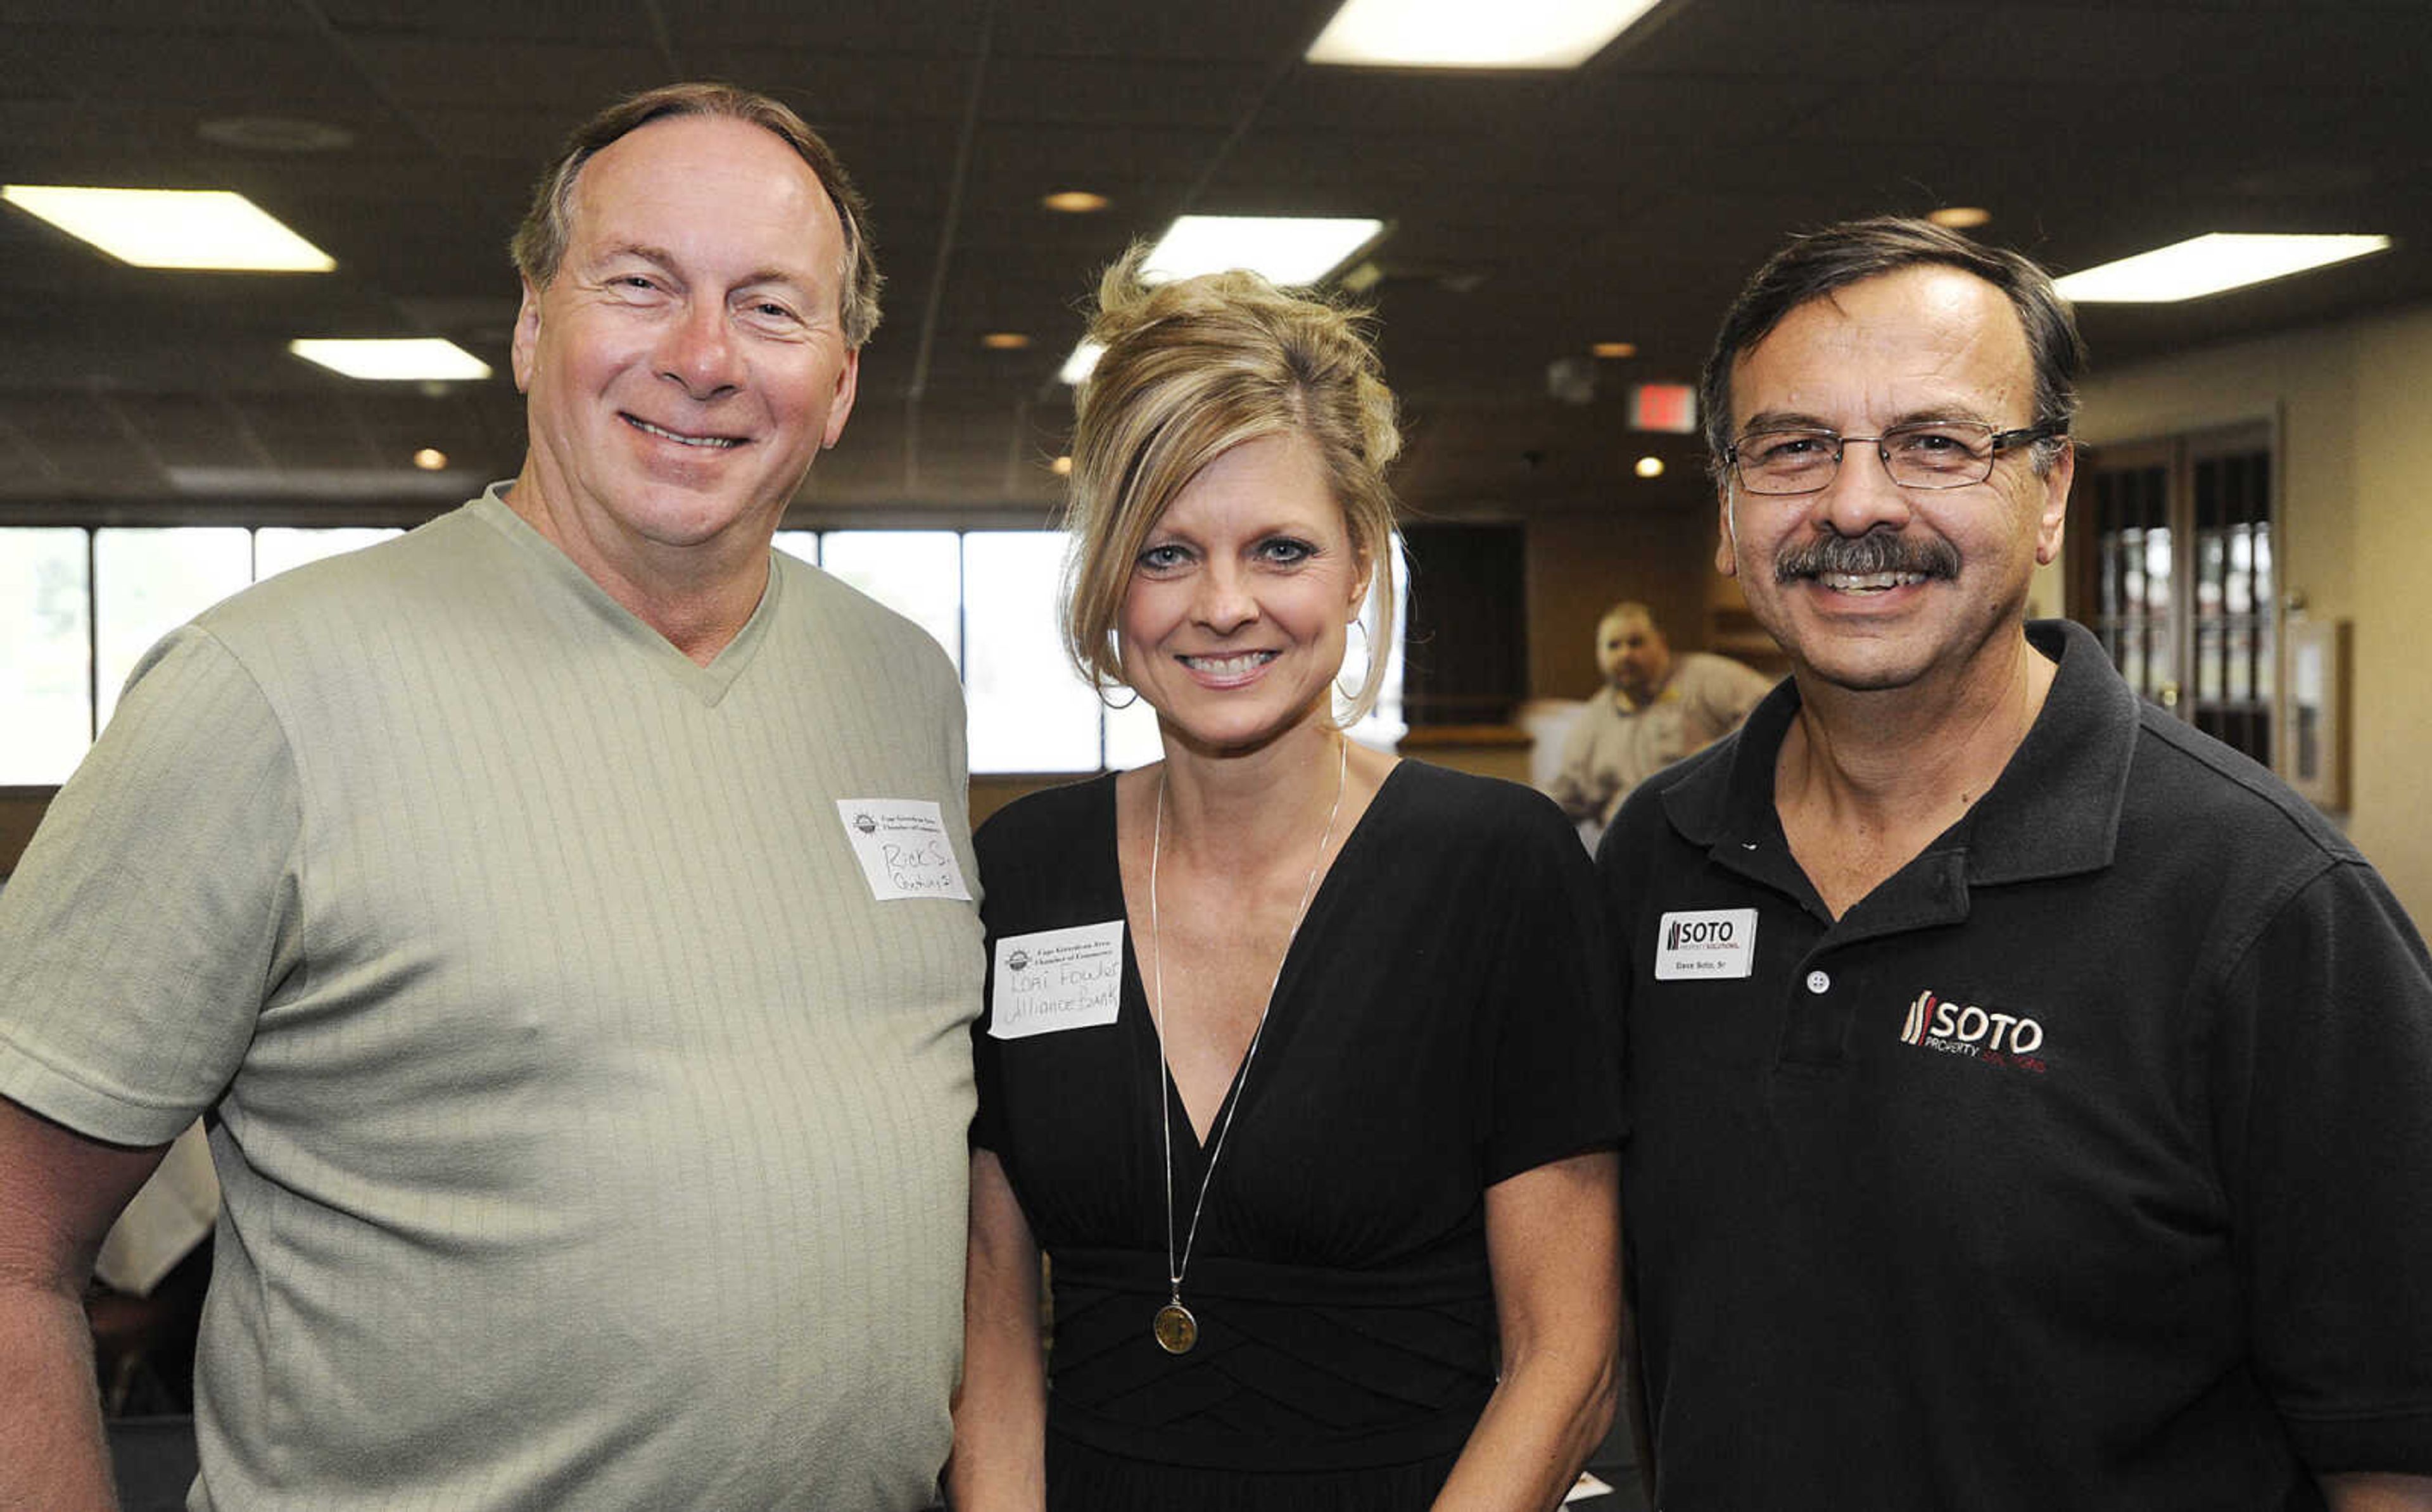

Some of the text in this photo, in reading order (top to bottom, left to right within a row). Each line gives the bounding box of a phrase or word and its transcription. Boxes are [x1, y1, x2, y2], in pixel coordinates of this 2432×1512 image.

[1681, 921, 1733, 943] SOTO
[1931, 1002, 2043, 1054] SOTO
[1925, 1036, 1980, 1057] PROPERTY
